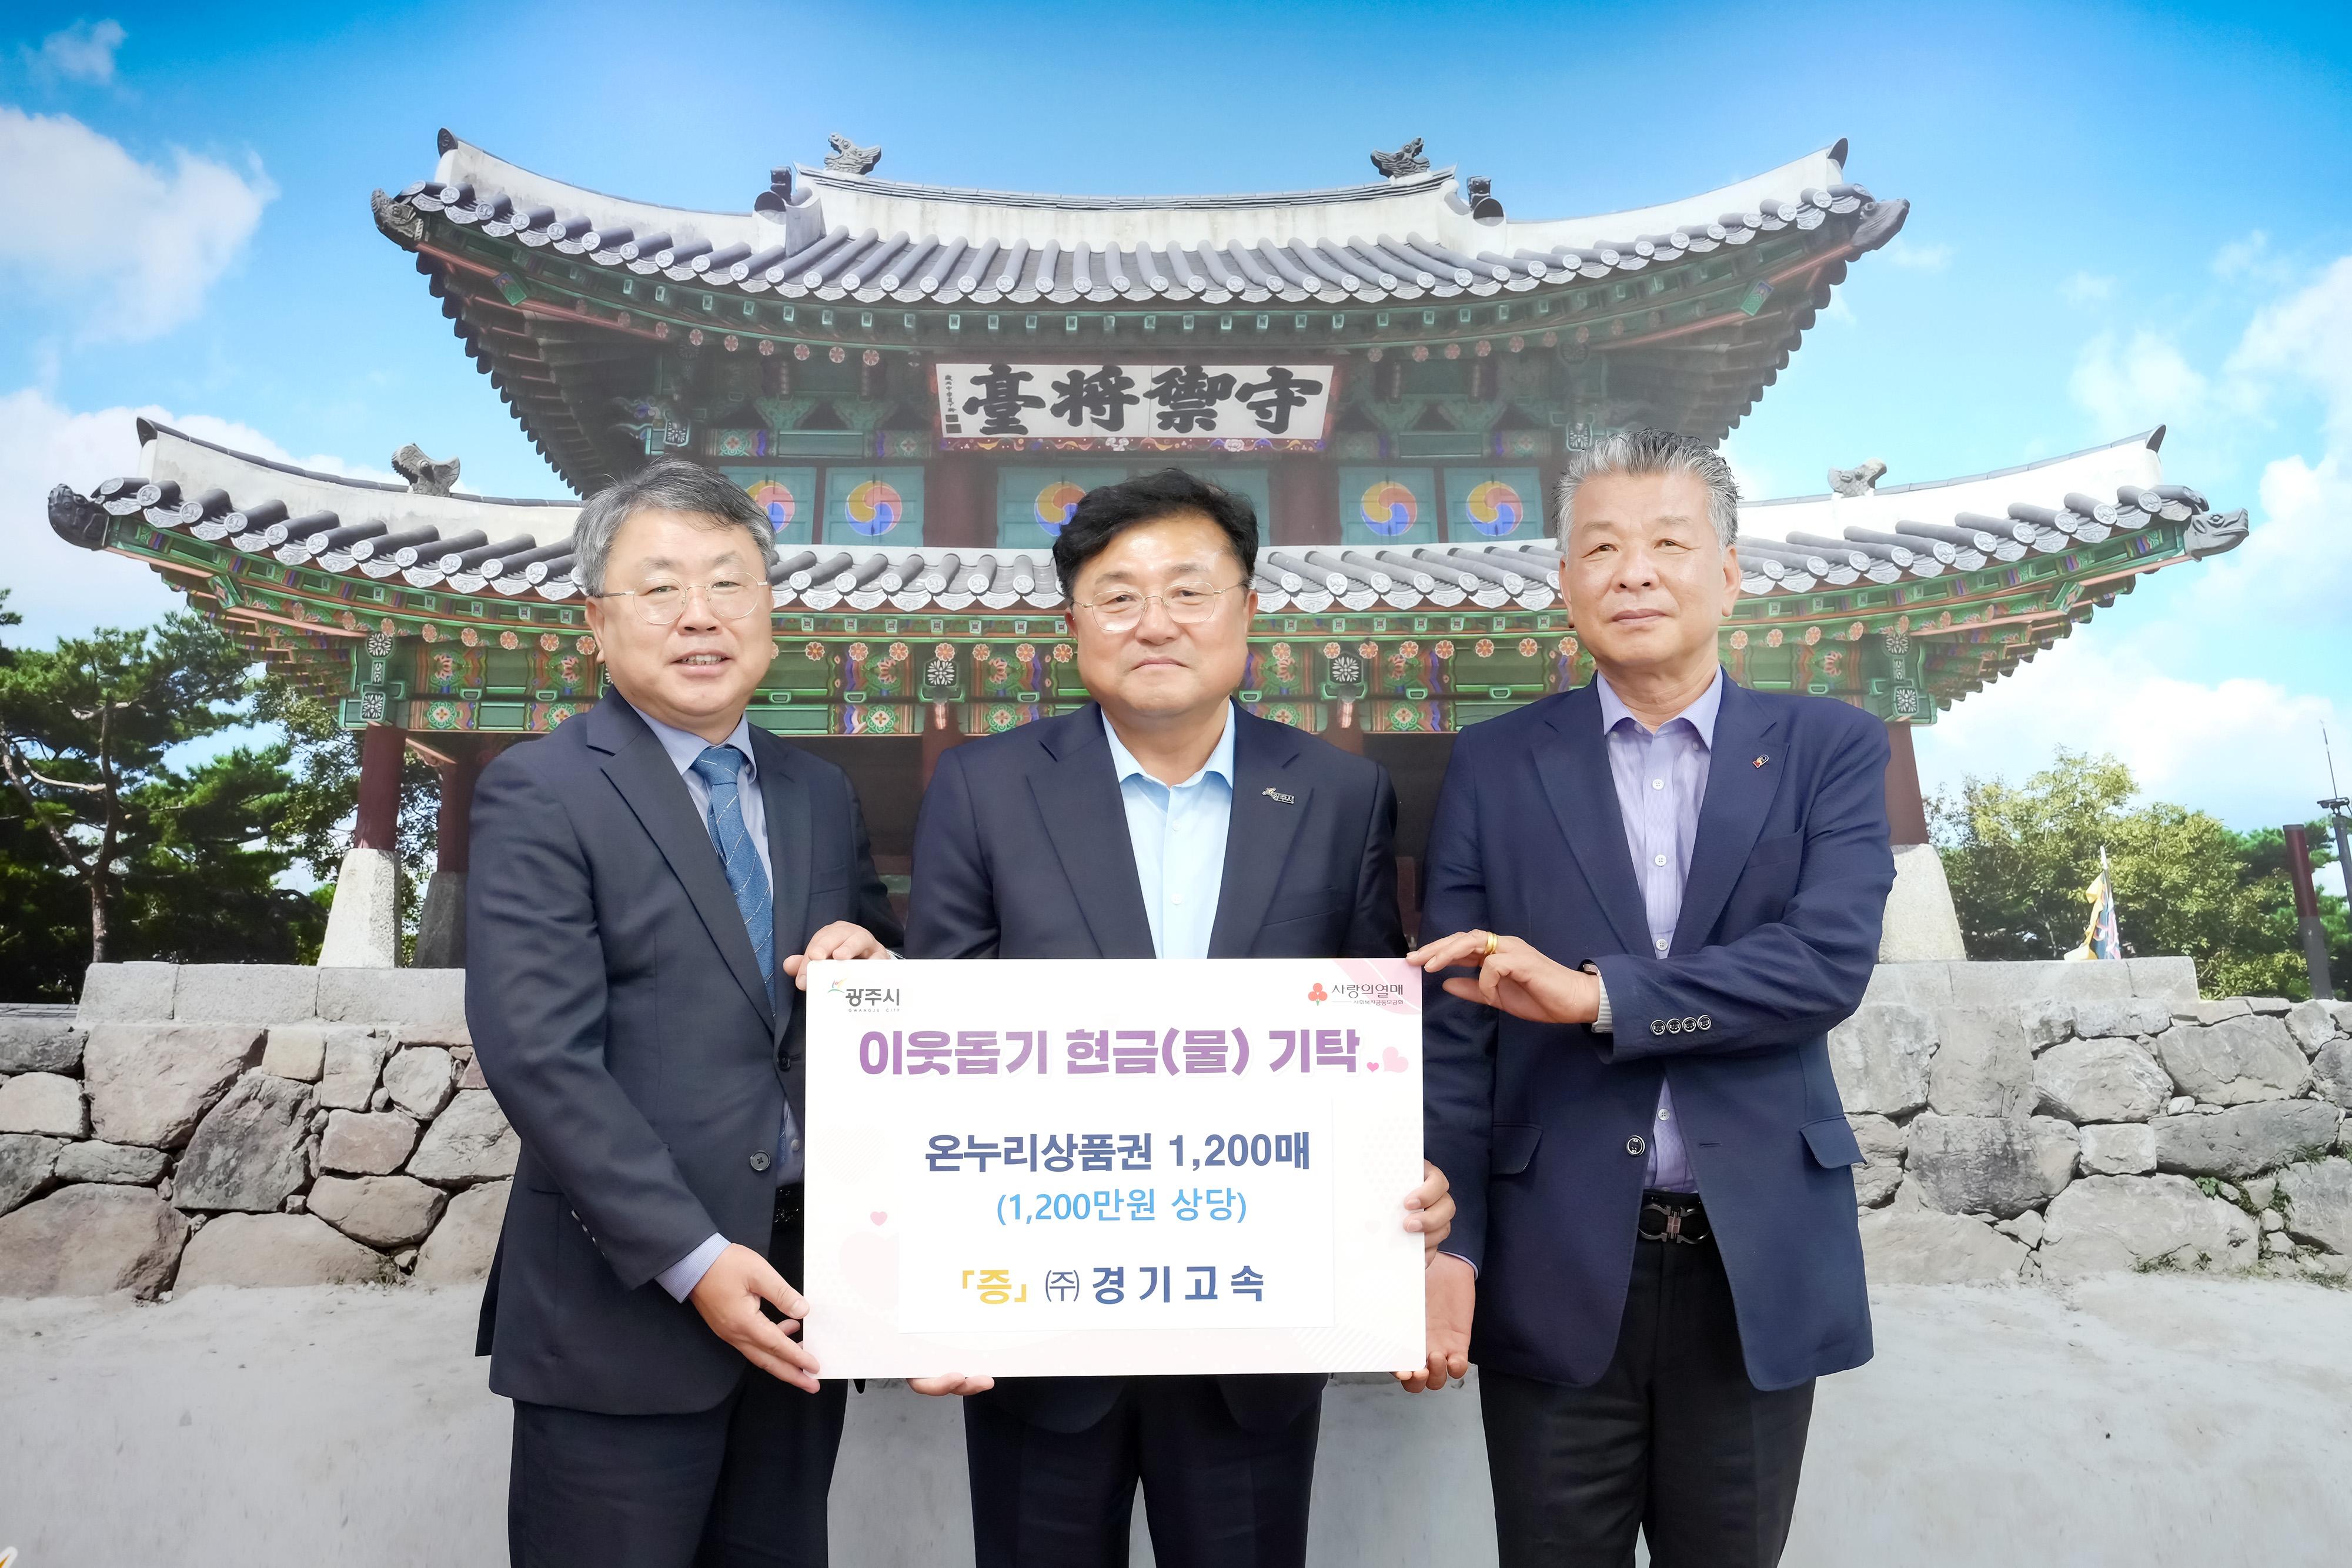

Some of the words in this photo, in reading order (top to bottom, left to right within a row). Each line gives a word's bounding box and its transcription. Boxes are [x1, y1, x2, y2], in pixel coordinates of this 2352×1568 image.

[845, 988, 900, 1007] 광주시
[1331, 984, 1403, 999] 사랑의열매
[859, 1030, 1047, 1075] 이웃돕기
[1066, 1027, 1250, 1076] 현금(물)
[1269, 1029, 1361, 1073] 기탁
[925, 1132, 1152, 1173] 온누리상품권
[1169, 1131, 1309, 1172] 1,200매
[997, 1188, 1155, 1226] (1,200만원
[1171, 1187, 1247, 1223] 상당)
